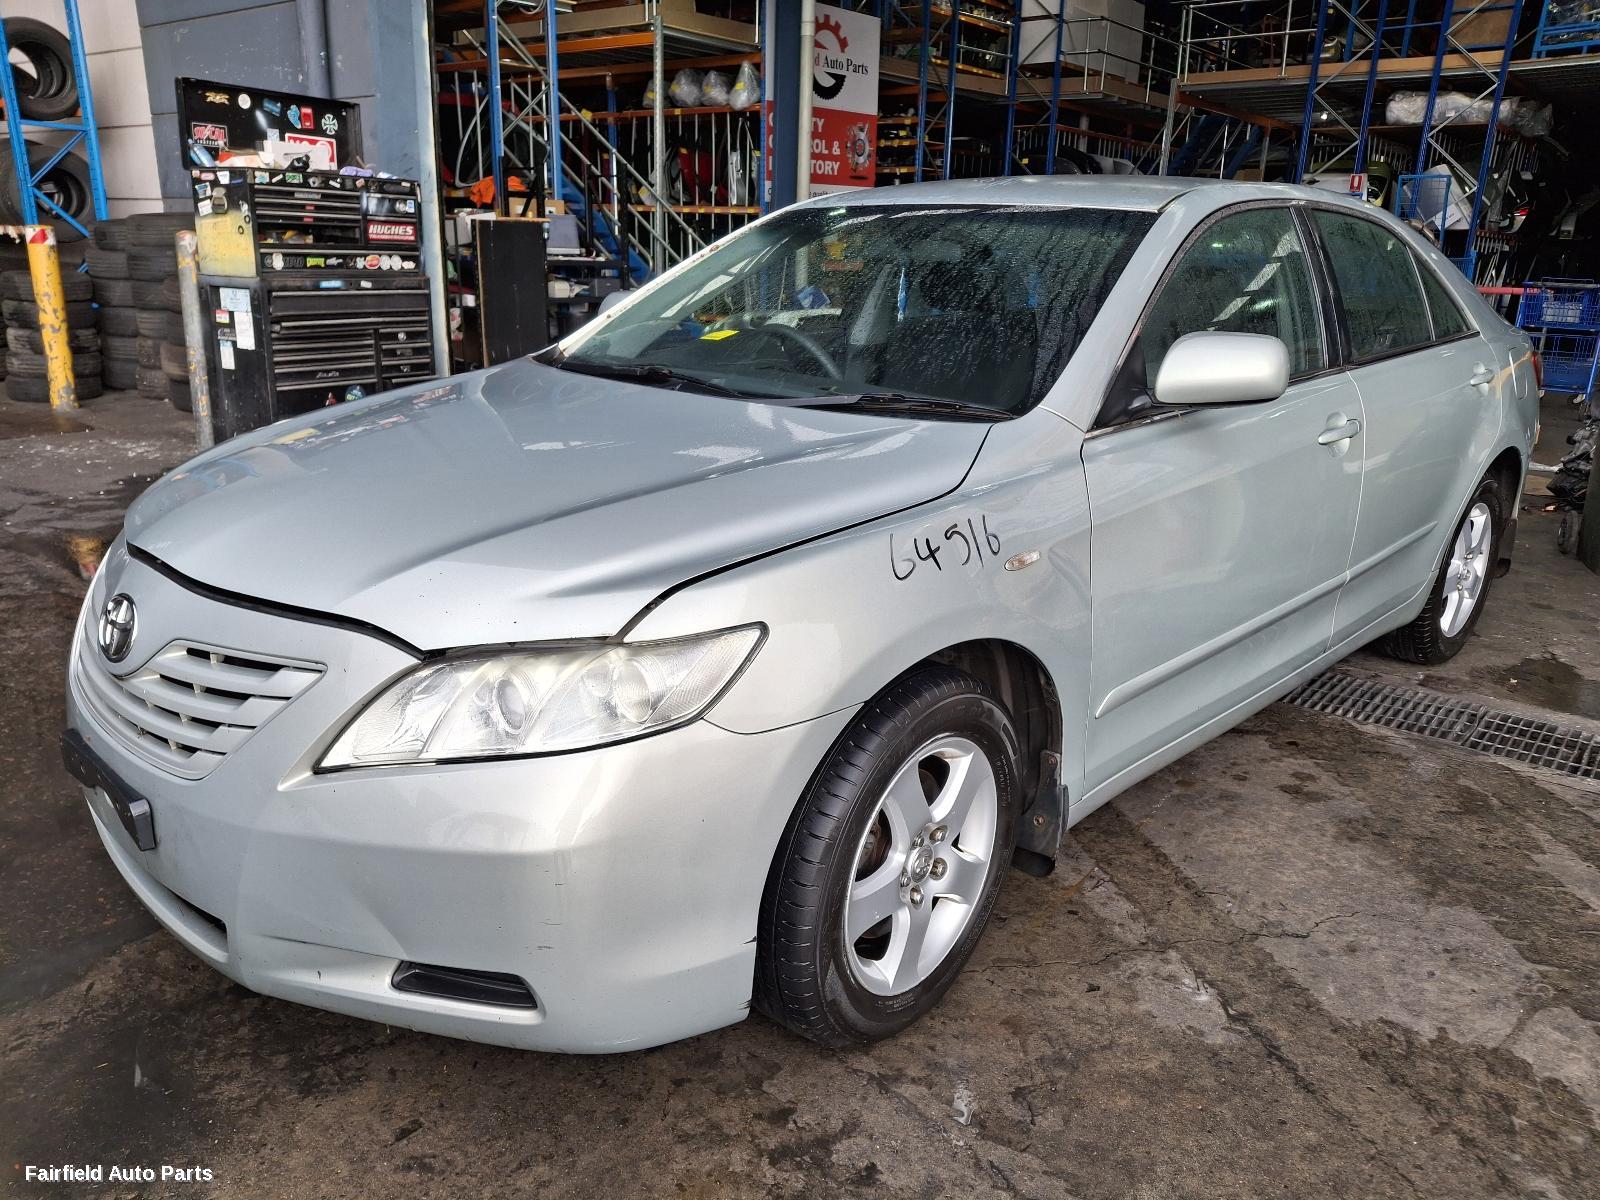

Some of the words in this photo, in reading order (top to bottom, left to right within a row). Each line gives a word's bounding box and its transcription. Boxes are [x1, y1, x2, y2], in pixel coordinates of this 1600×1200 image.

[822, 55, 844, 71] Auto
[846, 58, 869, 76] Parts
[832, 141, 841, 156] &
[368, 224, 415, 236] HUGHES
[889, 514, 1001, 582] 64516
